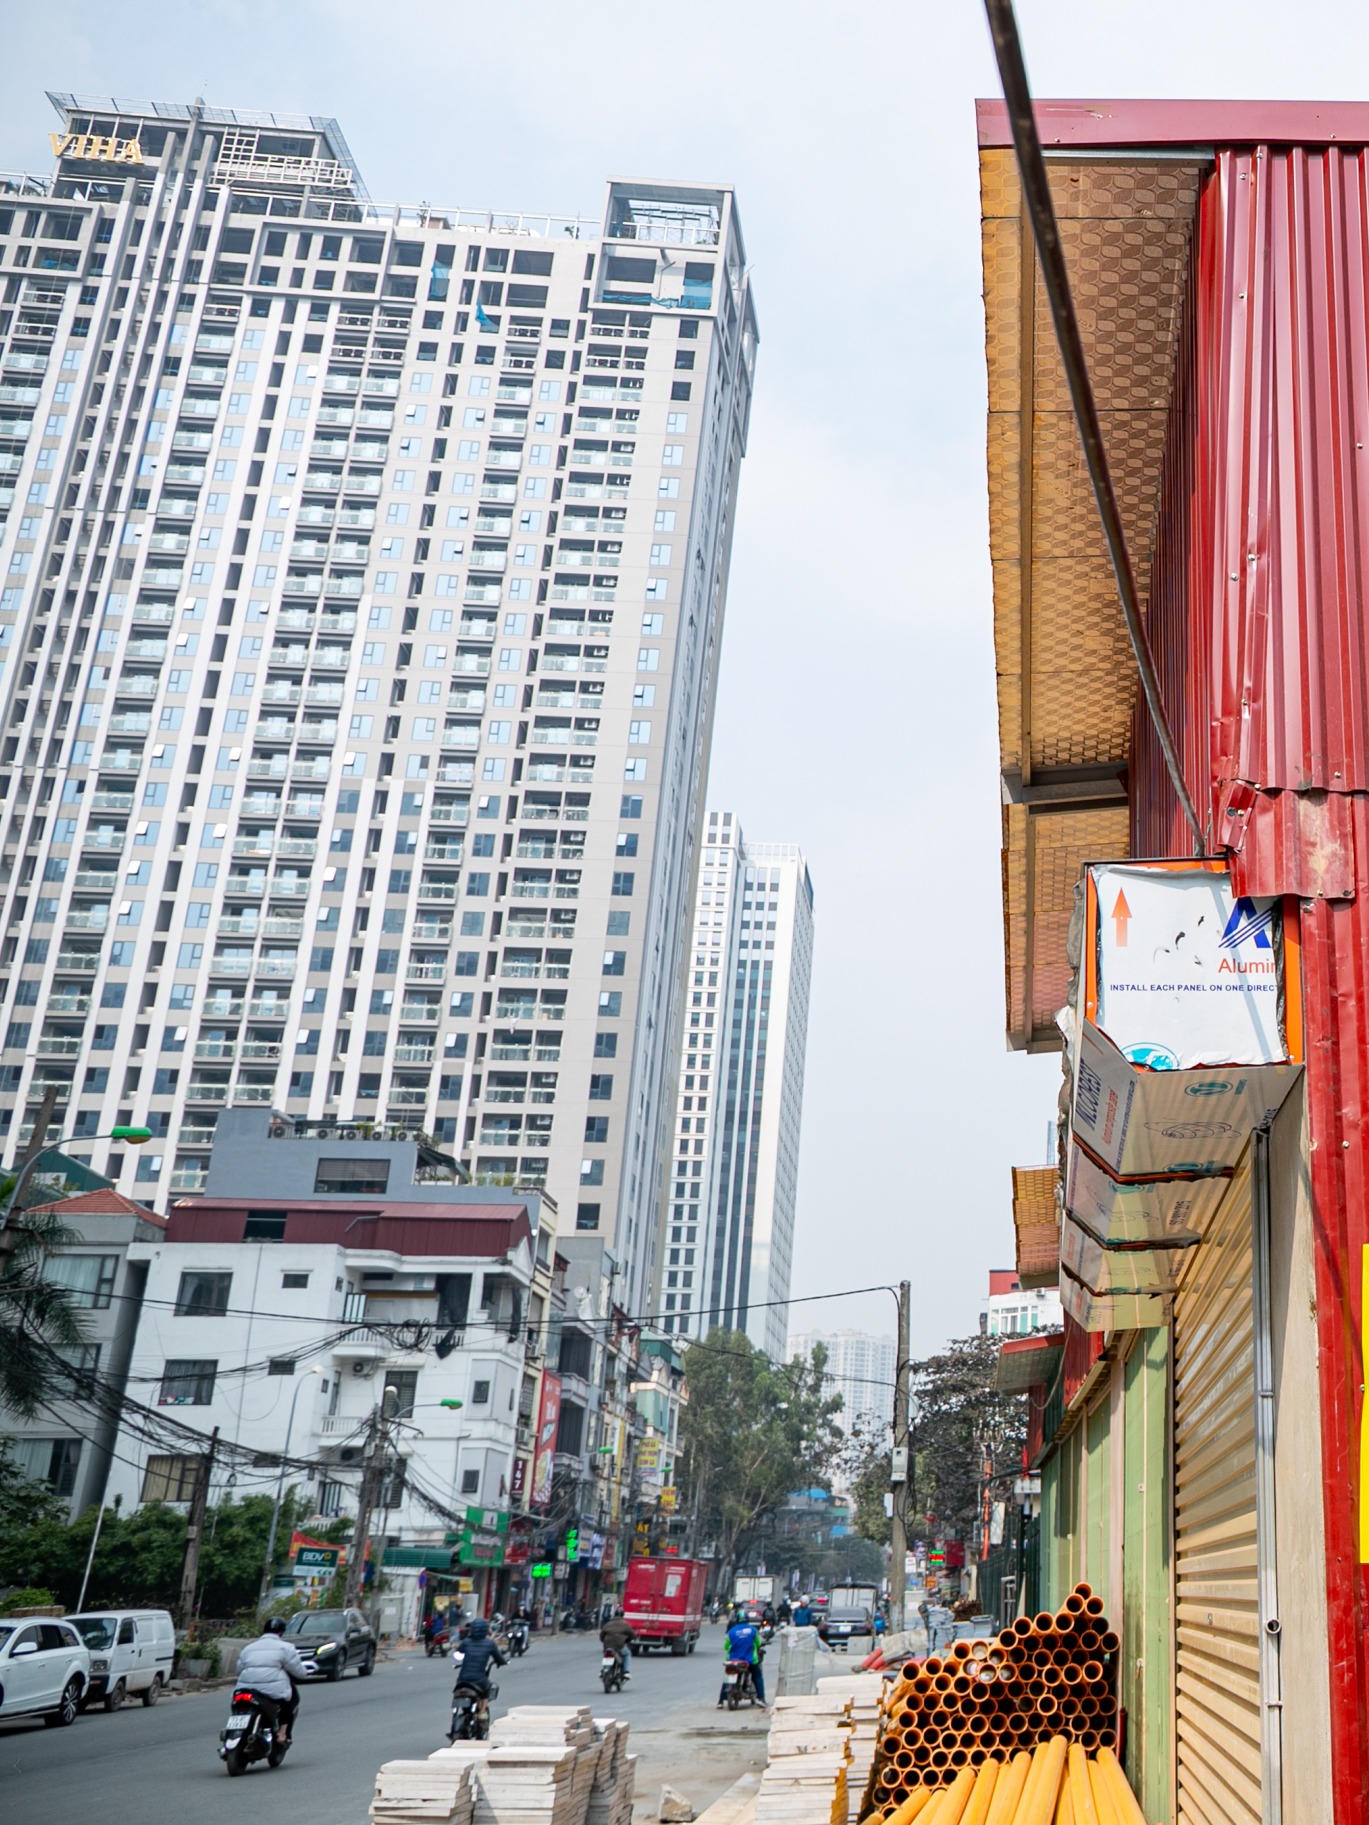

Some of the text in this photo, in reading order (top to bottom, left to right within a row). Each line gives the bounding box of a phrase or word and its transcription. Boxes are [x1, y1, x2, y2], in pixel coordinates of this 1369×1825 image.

[48, 132, 145, 164] VIHA
[1109, 984, 1148, 992] INSTALL
[1150, 984, 1175, 992] EACH
[1177, 984, 1208, 992] PANEL
[1209, 984, 1223, 992] ON
[1225, 984, 1245, 992] ONE
